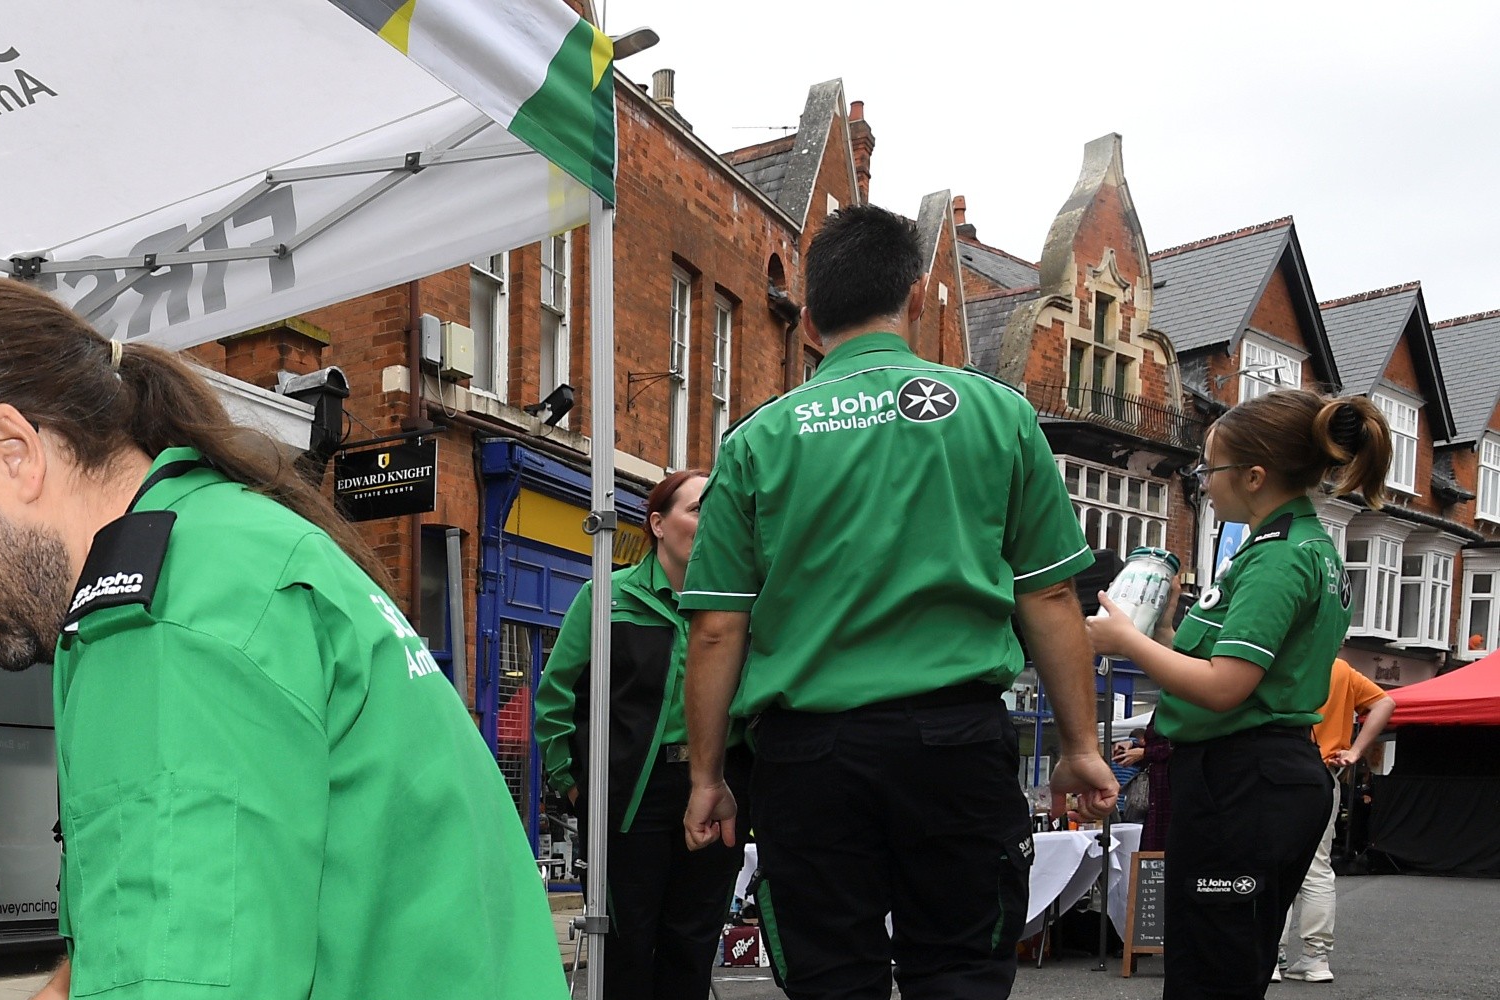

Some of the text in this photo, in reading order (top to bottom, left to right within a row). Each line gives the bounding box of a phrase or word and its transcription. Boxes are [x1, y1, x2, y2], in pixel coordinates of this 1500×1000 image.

[794, 390, 894, 422] St John
[799, 409, 897, 435] Ambulance
[337, 465, 433, 490] EDWARD KNIGHT
[354, 485, 414, 499] ESTATE AGENTS
[92, 572, 144, 592] John
[1197, 878, 1231, 887] St John
[731, 935, 755, 959] Pepper
[736, 938, 745, 947] Dr
